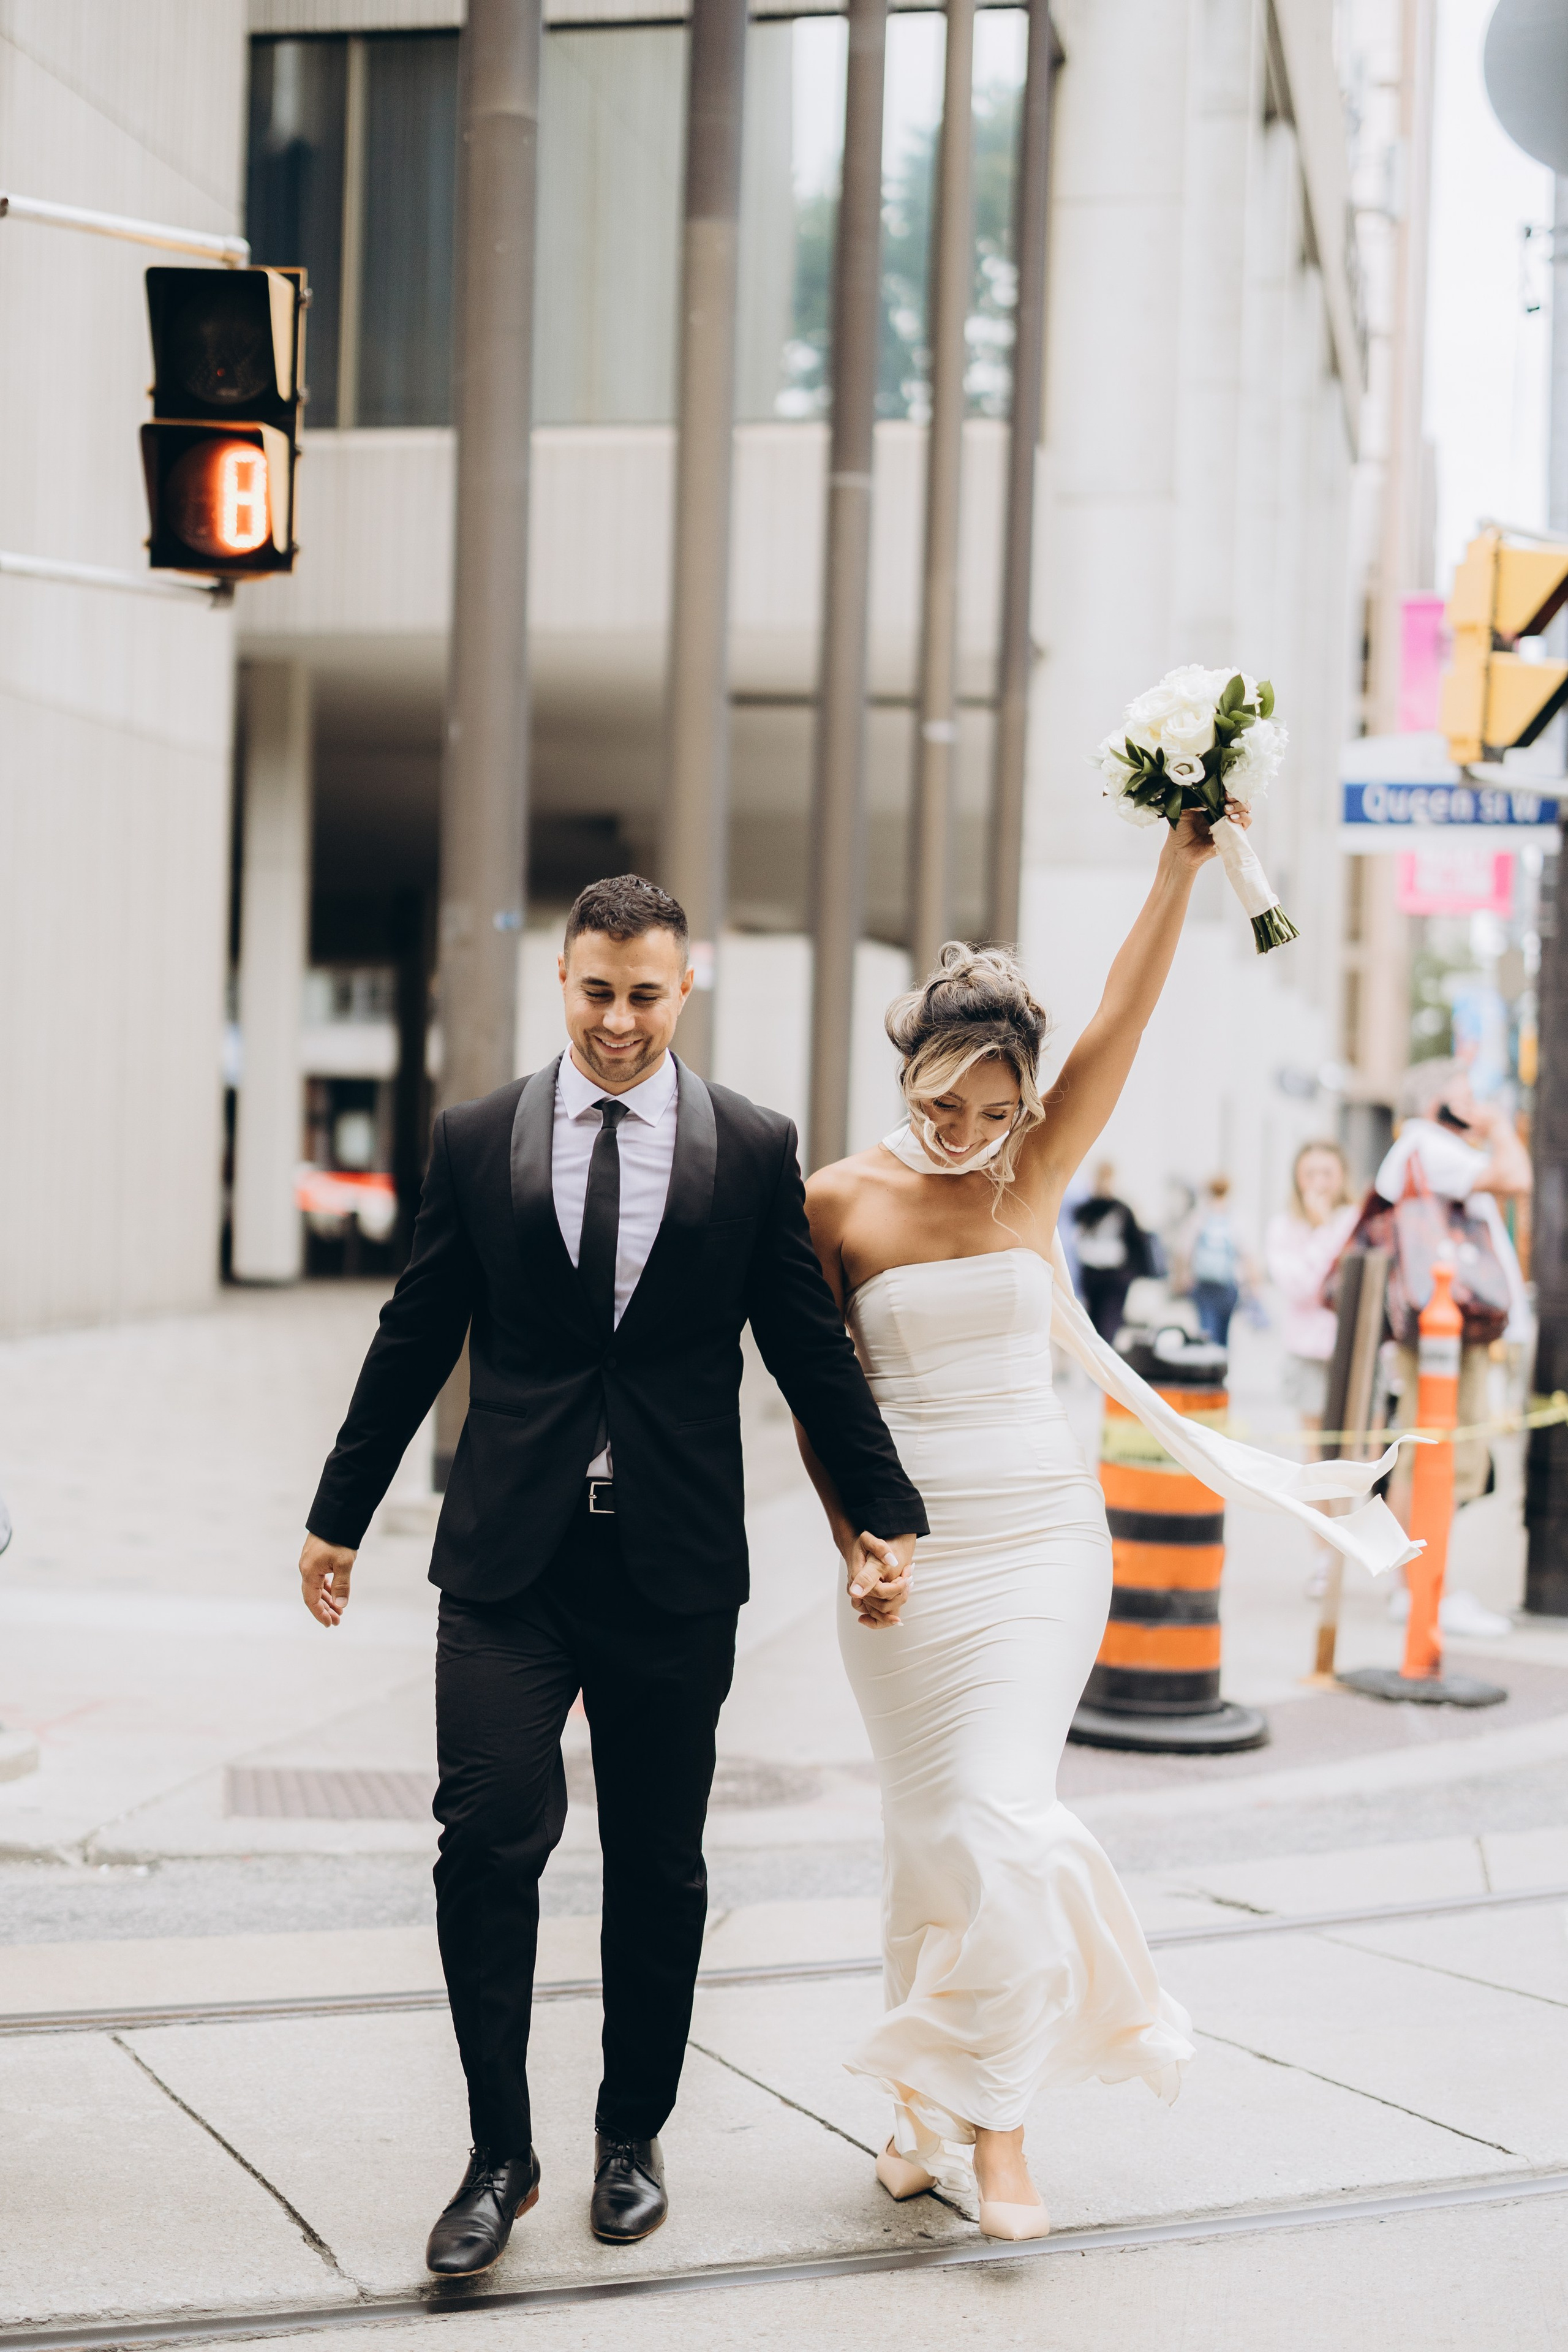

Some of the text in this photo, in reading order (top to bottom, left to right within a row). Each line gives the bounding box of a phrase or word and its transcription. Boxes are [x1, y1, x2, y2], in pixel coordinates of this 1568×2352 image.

[224, 451, 267, 548] 8
[1362, 784, 1474, 822] Queen
[1510, 789, 1540, 822] W
